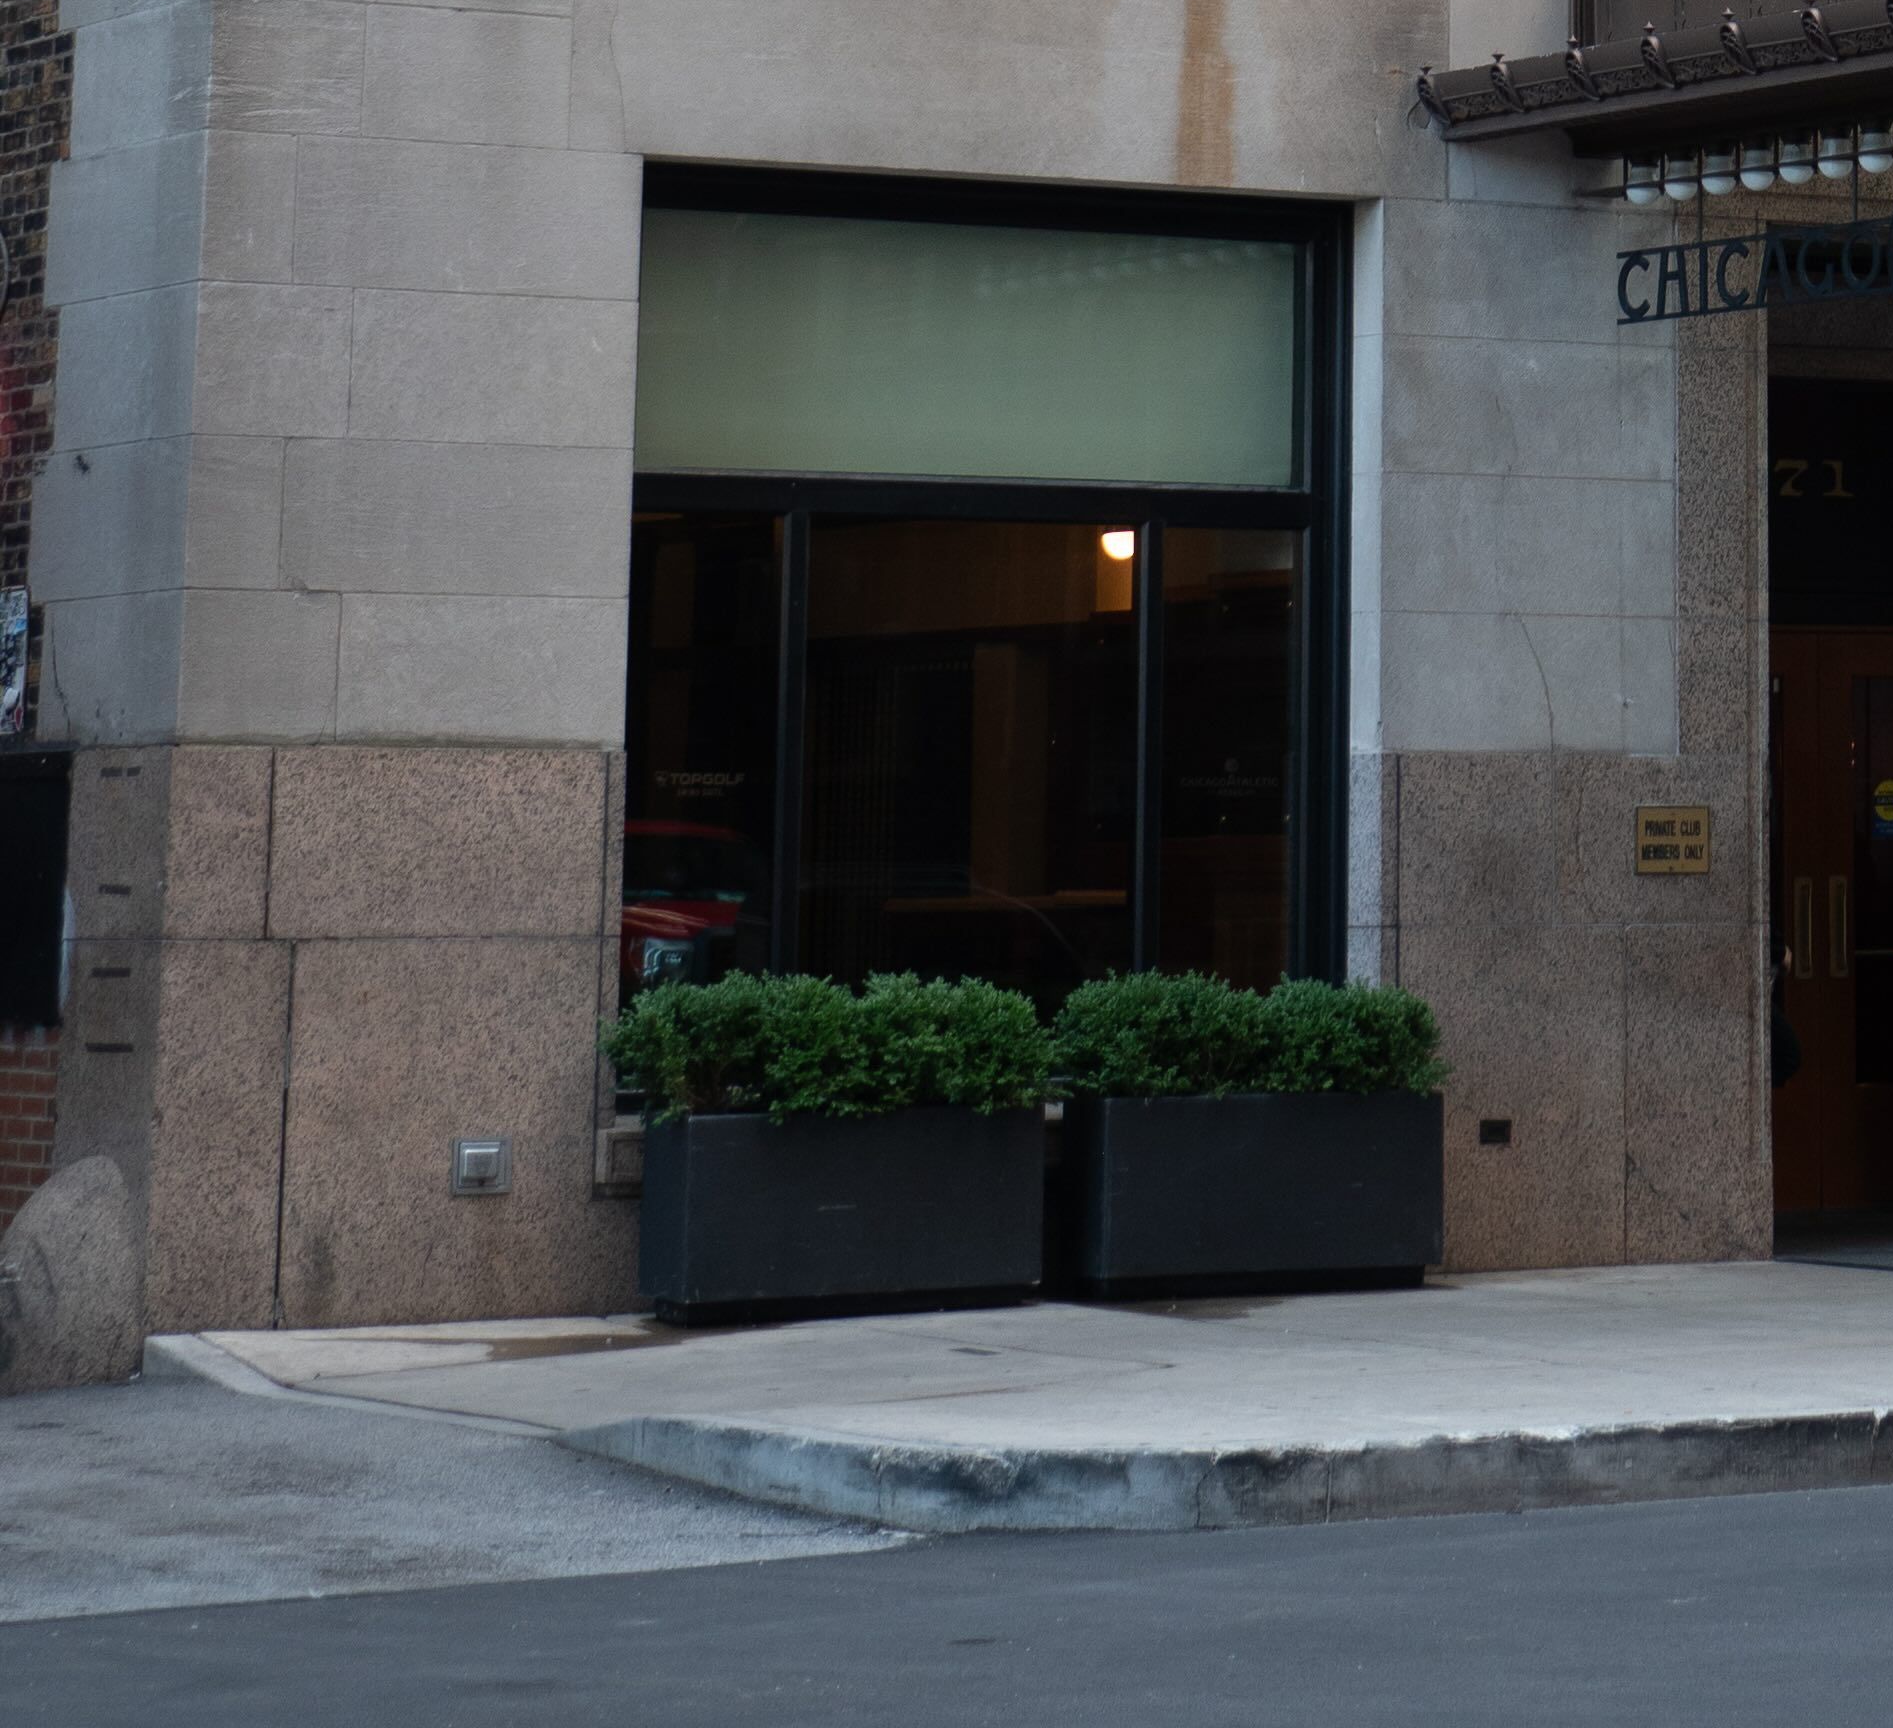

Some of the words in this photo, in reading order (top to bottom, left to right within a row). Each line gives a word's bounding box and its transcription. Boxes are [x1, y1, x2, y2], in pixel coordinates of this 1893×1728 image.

[1617, 229, 1883, 322] CHICAGO
[1773, 458, 1855, 498] 71
[671, 772, 745, 785] TOPGOLF
[1645, 820, 1676, 836] PRIVATE
[1681, 820, 1701, 836] CLUB
[1642, 844, 1680, 860] MEMBERS
[1685, 844, 1704, 859] ONLY
